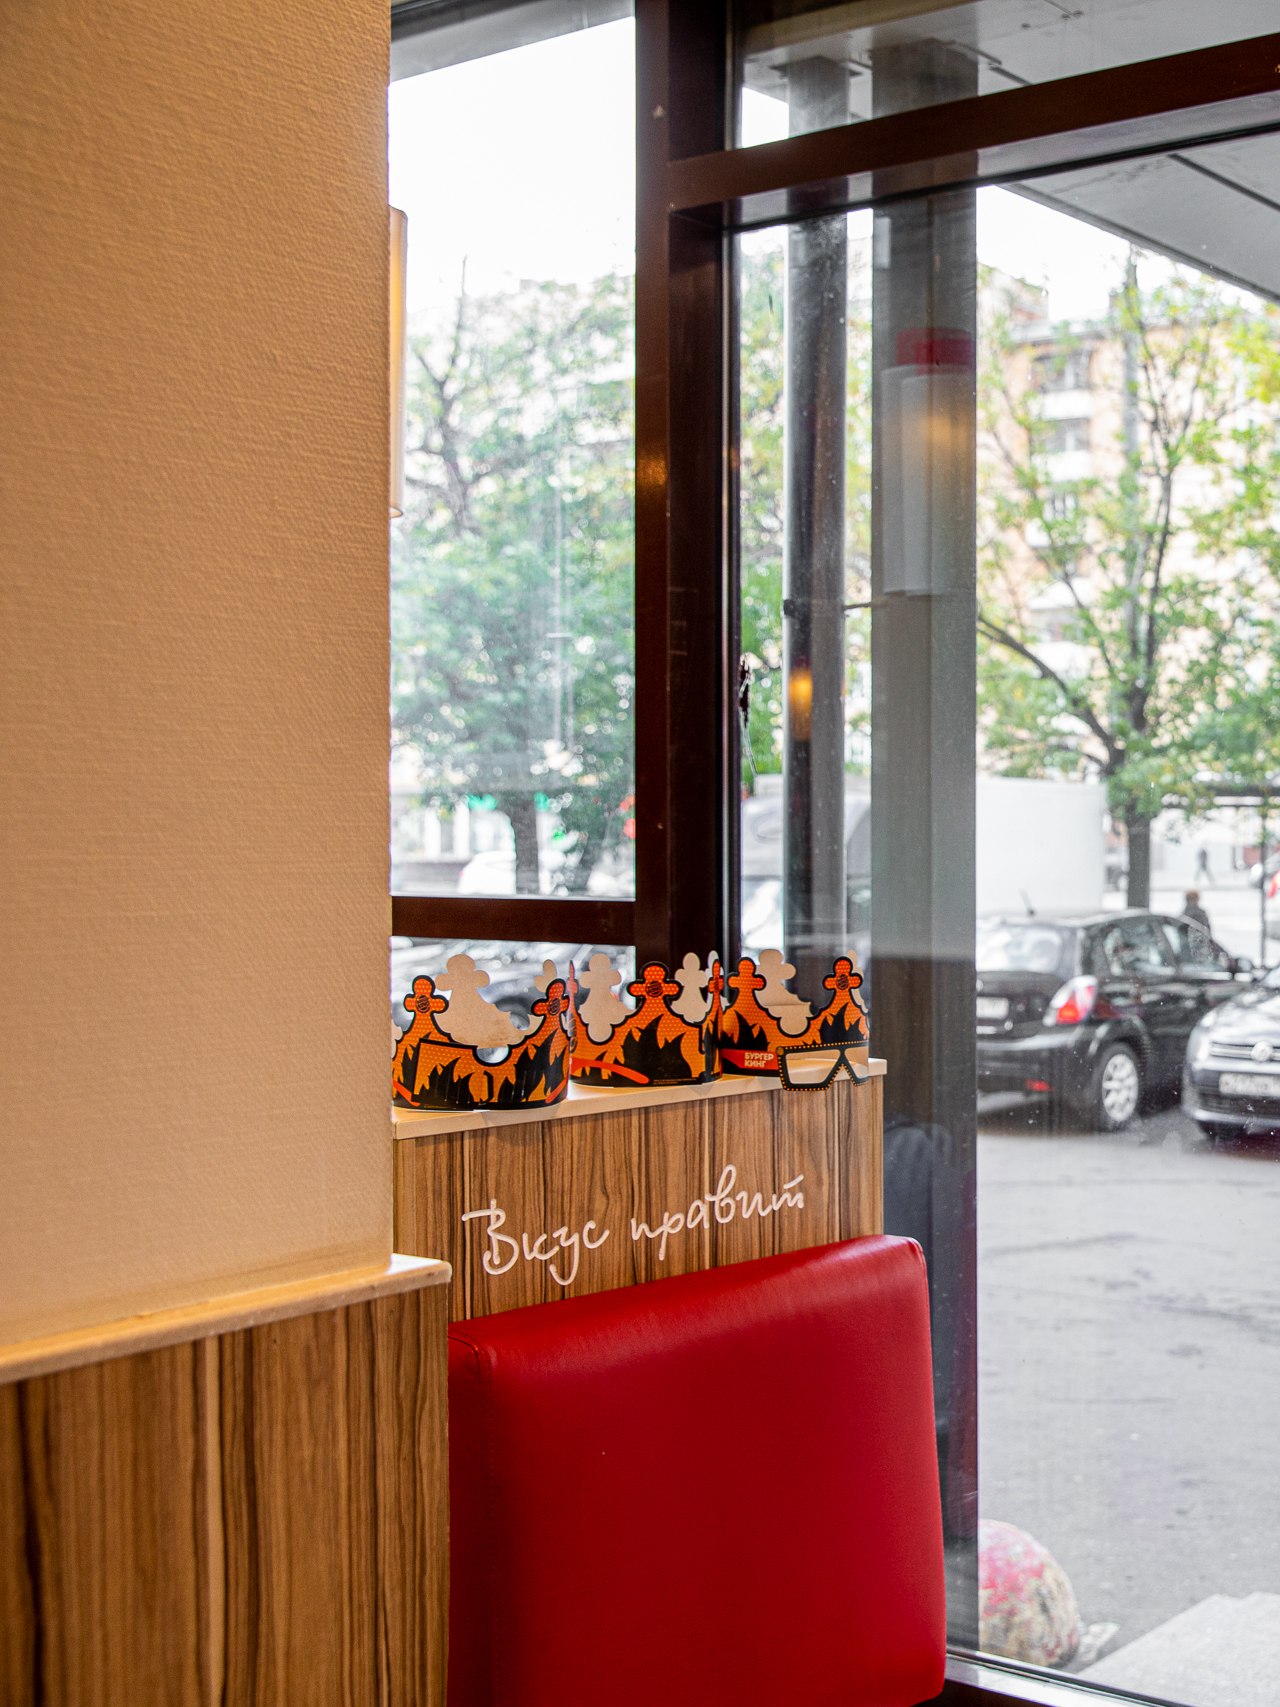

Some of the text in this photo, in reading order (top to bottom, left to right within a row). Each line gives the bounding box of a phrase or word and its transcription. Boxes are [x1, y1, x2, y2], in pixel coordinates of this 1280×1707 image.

[744, 1051, 775, 1061] БУРГЕР
[744, 1059, 767, 1068] КИНГ
[461, 1163, 804, 1286] Вкус правит
